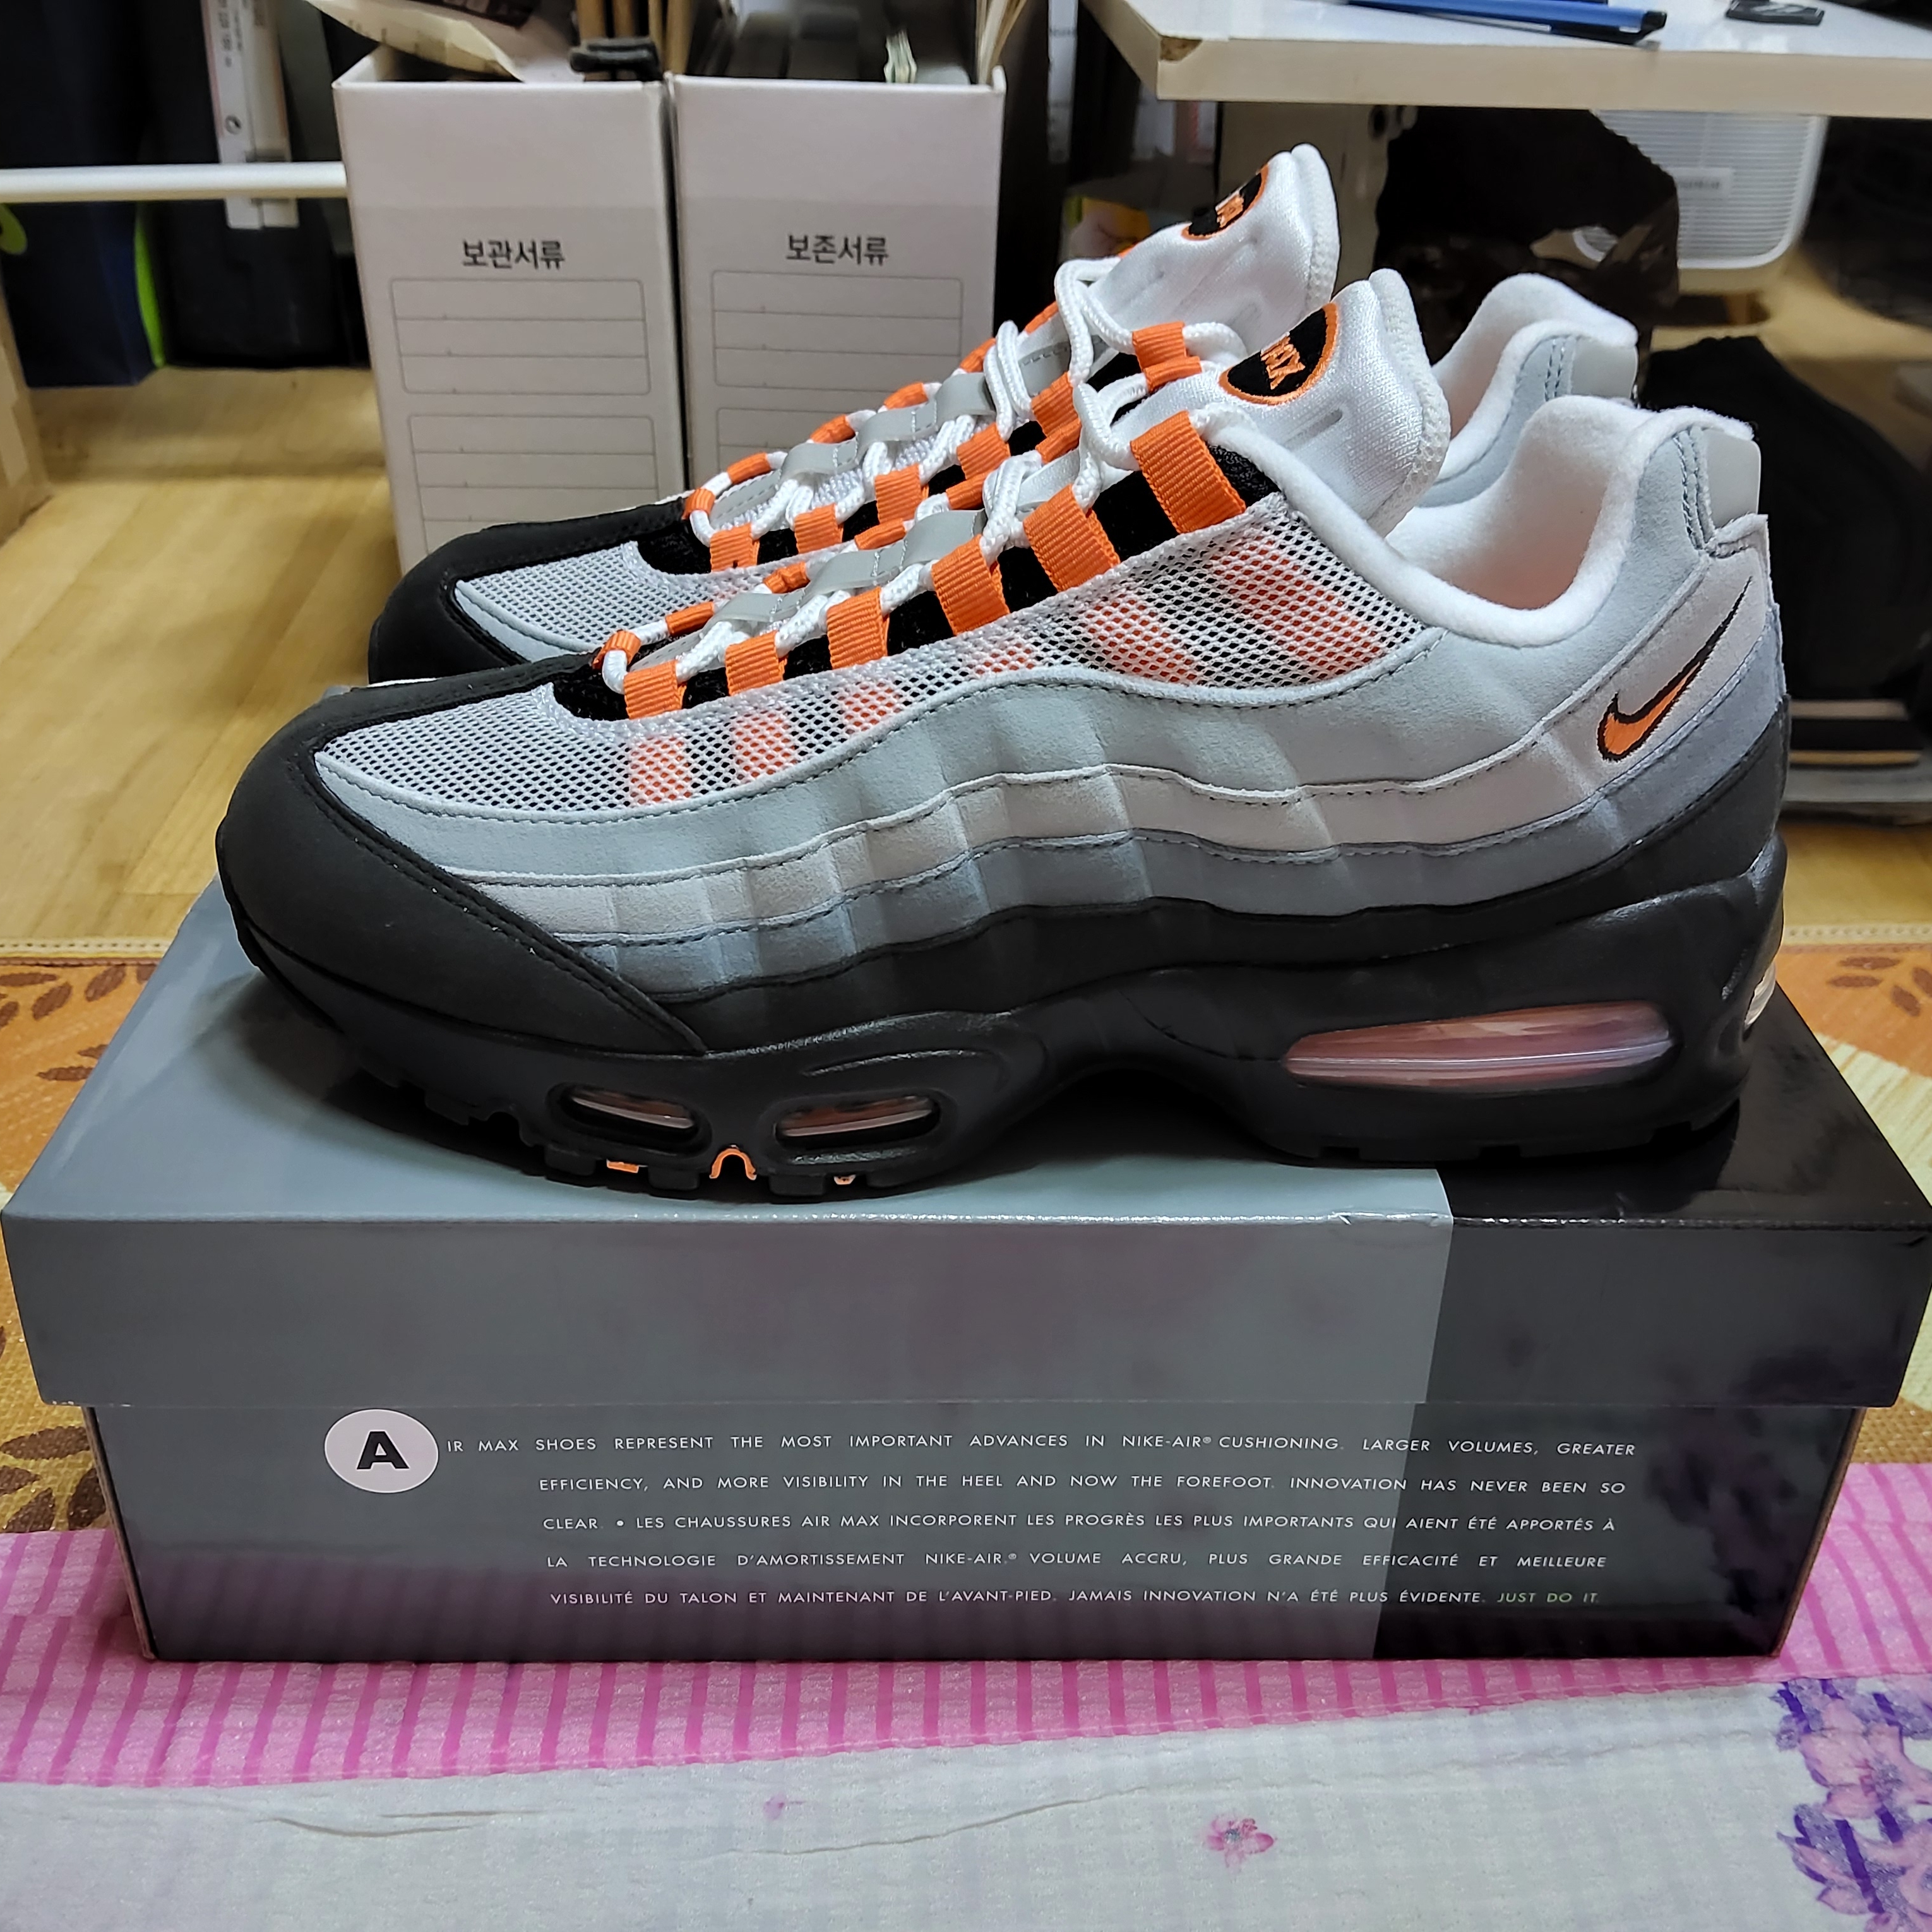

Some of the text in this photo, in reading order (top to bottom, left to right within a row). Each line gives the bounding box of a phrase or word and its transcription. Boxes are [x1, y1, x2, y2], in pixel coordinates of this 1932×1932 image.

[462, 239, 566, 270] 보관서류
[786, 234, 890, 265] 보존서류
[447, 1440, 464, 1452] IR
[478, 1438, 519, 1452] MAX
[535, 1437, 597, 1452] SHOES
[614, 1435, 713, 1450] REPRESENT
[730, 1434, 763, 1448] THE
[780, 1434, 832, 1448] MOST
[850, 1433, 953, 1447] IMPORTANT
[969, 1433, 1068, 1447] ADVANCES
[1085, 1434, 1104, 1447] IN
[1363, 1438, 1430, 1452] LARGER
[1448, 1439, 1539, 1455] VOLUMES,
[1557, 1441, 1636, 1456] GREATER
[540, 1476, 648, 1491] EFFICIENCY,
[663, 1476, 703, 1489] AND
[717, 1475, 769, 1489] MORE
[782, 1474, 868, 1488] VISIBILITY
[883, 1474, 902, 1488] IN
[915, 1474, 948, 1488] THE
[962, 1474, 1003, 1487] HEEL
[1016, 1474, 1056, 1487] AND
[1070, 1474, 1118, 1487] NOW
[1131, 1474, 1163, 1488] THE
[1290, 1476, 1407, 1490] INNOVATION
[1420, 1479, 1457, 1491] HAS
[1470, 1479, 1529, 1493] NEVER
[1541, 1480, 1587, 1493] BEEN
[1600, 1481, 1626, 1494] SO
[636, 1515, 664, 1529] LES
[674, 1515, 791, 1529] CHAUSSURES
[801, 1514, 830, 1527] AIR
[840, 1514, 880, 1527] MAX
[890, 1513, 1017, 1527] INCORPORENT
[1027, 1513, 1054, 1525] LES
[1065, 1511, 1145, 1526] PROGRÈS
[1155, 1513, 1183, 1526] LES
[1193, 1514, 1233, 1527] PLUS
[1243, 1515, 1354, 1528] IMPORTANTS
[1364, 1516, 1397, 1530] QUI
[1405, 1517, 1459, 1530] AIENT
[1467, 1515, 1498, 1530] ÉTÉ
[1505, 1517, 1594, 1531] APPORTÉS
[1602, 1517, 1615, 1531] À
[547, 1556, 568, 1568] LA
[588, 1553, 716, 1567] TECHNOLOGIE
[1029, 1552, 1102, 1564] VOLUME
[1121, 1551, 1187, 1566] ACCRU,
[1208, 1553, 1248, 1565] PLUS
[1268, 1553, 1342, 1565] GRANDE
[1363, 1553, 1459, 1568] EFFICACITÉ
[1479, 1555, 1498, 1567] ET
[1517, 1555, 1607, 1568] MEILLEURE
[550, 1590, 633, 1605] VISIBILITÉ
[645, 1592, 668, 1604] DU
[679, 1591, 737, 1604] TALON
[749, 1590, 767, 1603] ET
[778, 1590, 895, 1604] MAINTENANT
[906, 1590, 927, 1602] DE
[1068, 1589, 1132, 1601] JAMAIS
[1143, 1589, 1256, 1602] INNOVATION
[1310, 1588, 1339, 1602] ÉTÉ
[1349, 1590, 1388, 1603] PLUS
[1496, 1592, 1537, 1603] JUST
[1546, 1592, 1573, 1603] DO
